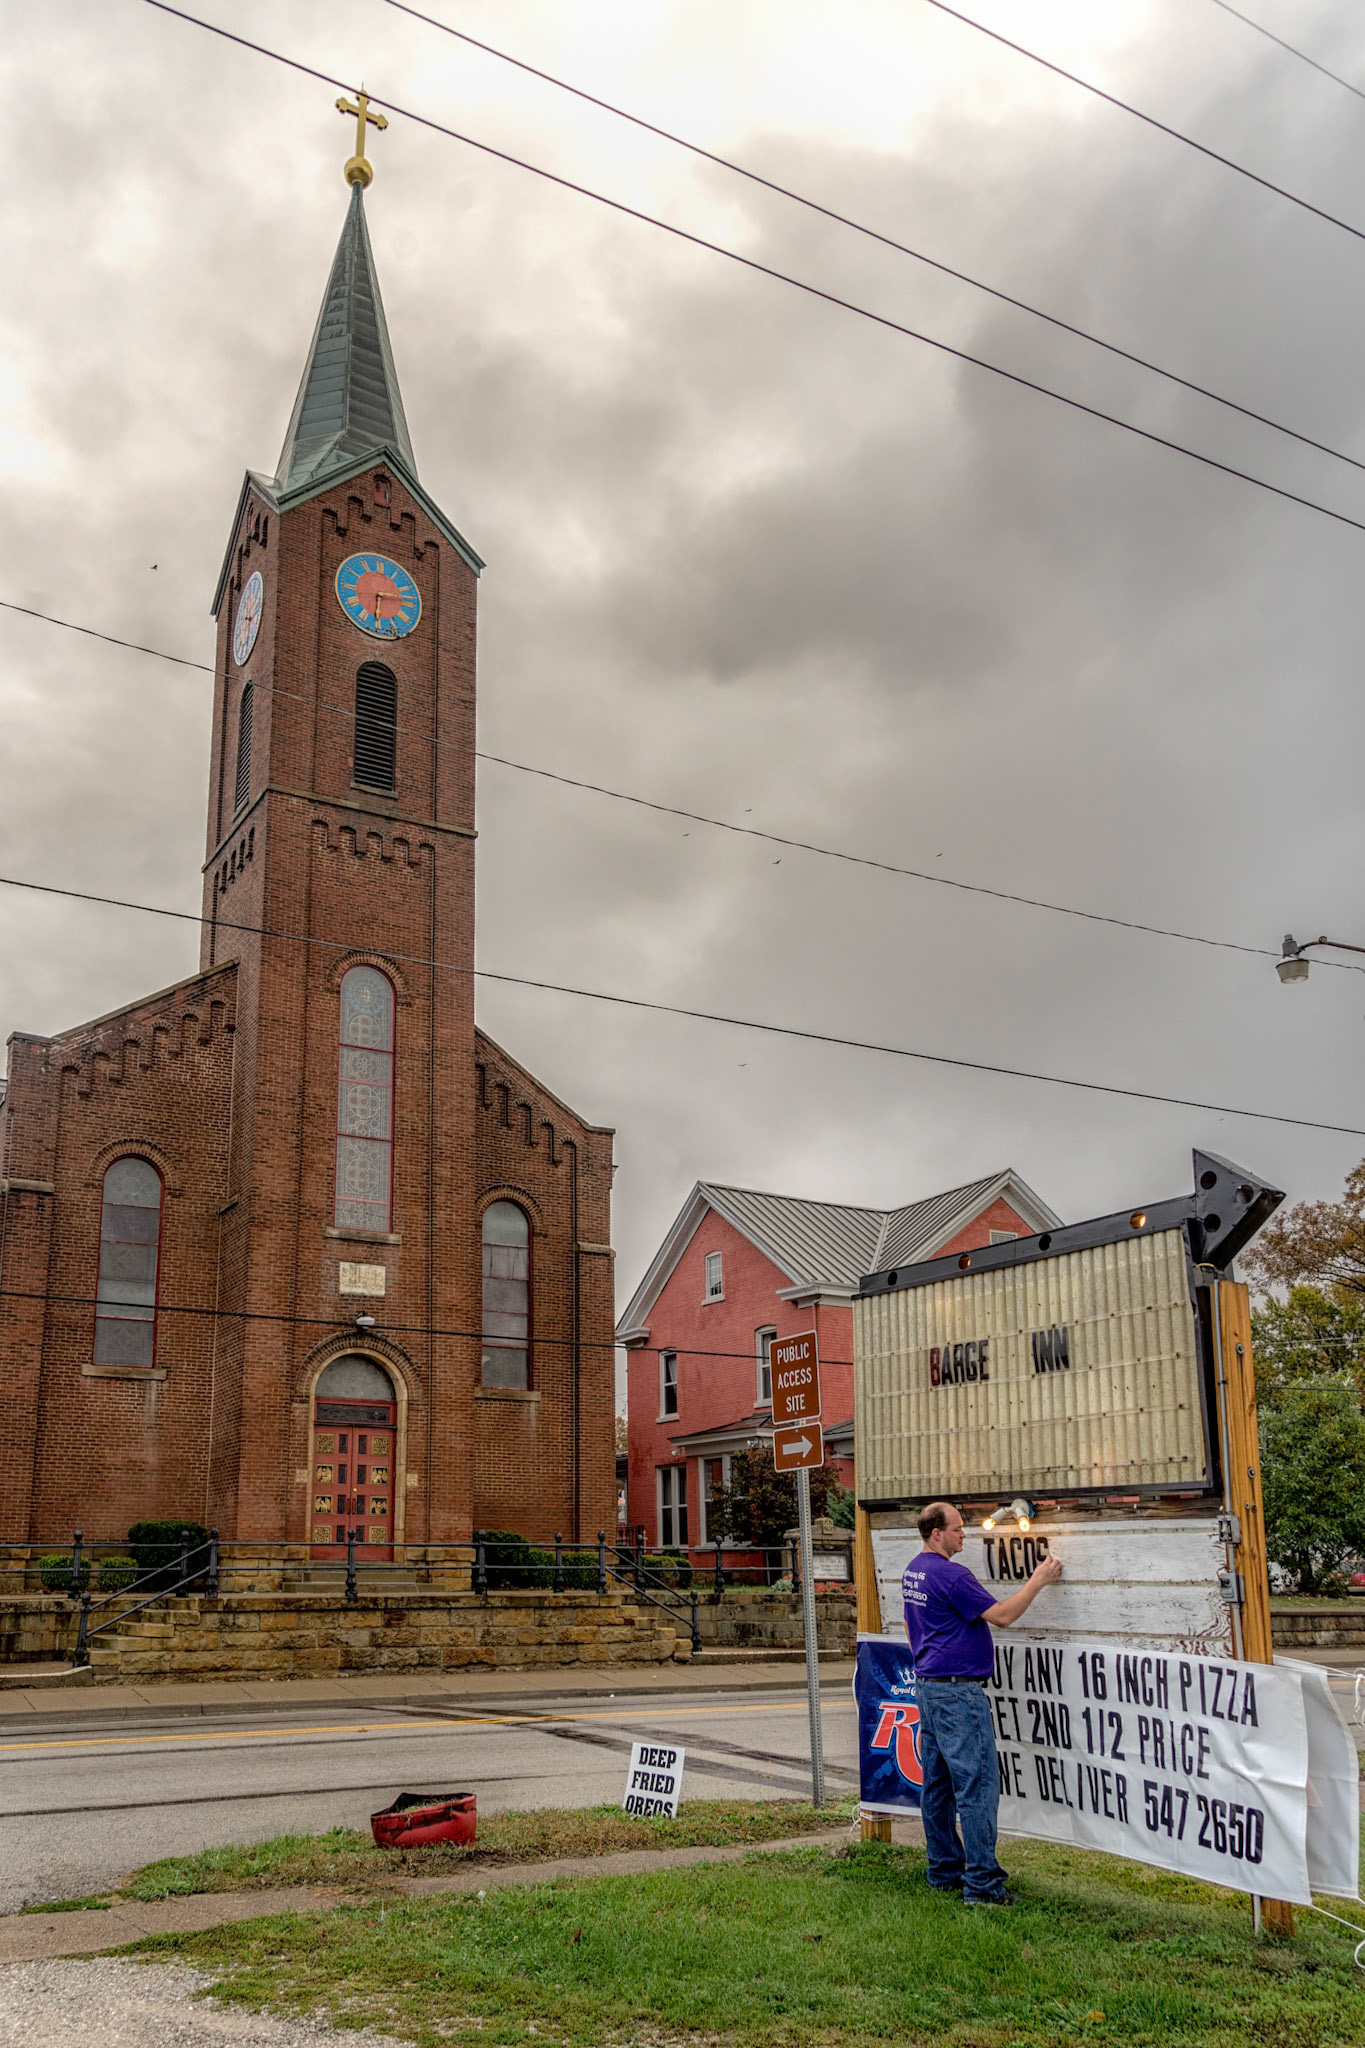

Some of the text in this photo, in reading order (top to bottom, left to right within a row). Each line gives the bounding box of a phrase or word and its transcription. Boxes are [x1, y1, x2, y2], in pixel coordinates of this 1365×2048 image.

[777, 1342, 810, 1364] PUBLIC
[929, 1327, 1069, 1387] BARGE INN
[777, 1367, 812, 1389] ACCESS
[786, 1394, 806, 1412] SITE
[918, 1571, 926, 1580] 66
[890, 1684, 911, 1696] Royal
[982, 1645, 1258, 1727] UY ANY 16 INCH PIZZA
[986, 1694, 1021, 1742] ET
[1027, 1699, 1072, 1750] 2ND
[1138, 1714, 1210, 1780] PRICE
[639, 1747, 677, 1769] DEEP
[631, 1771, 675, 1794] FRIED
[625, 1795, 673, 1819] OREOS
[1035, 1755, 1129, 1824] DELIVER
[1143, 1779, 1189, 1840] 547
[1196, 1794, 1264, 1864] 2650
